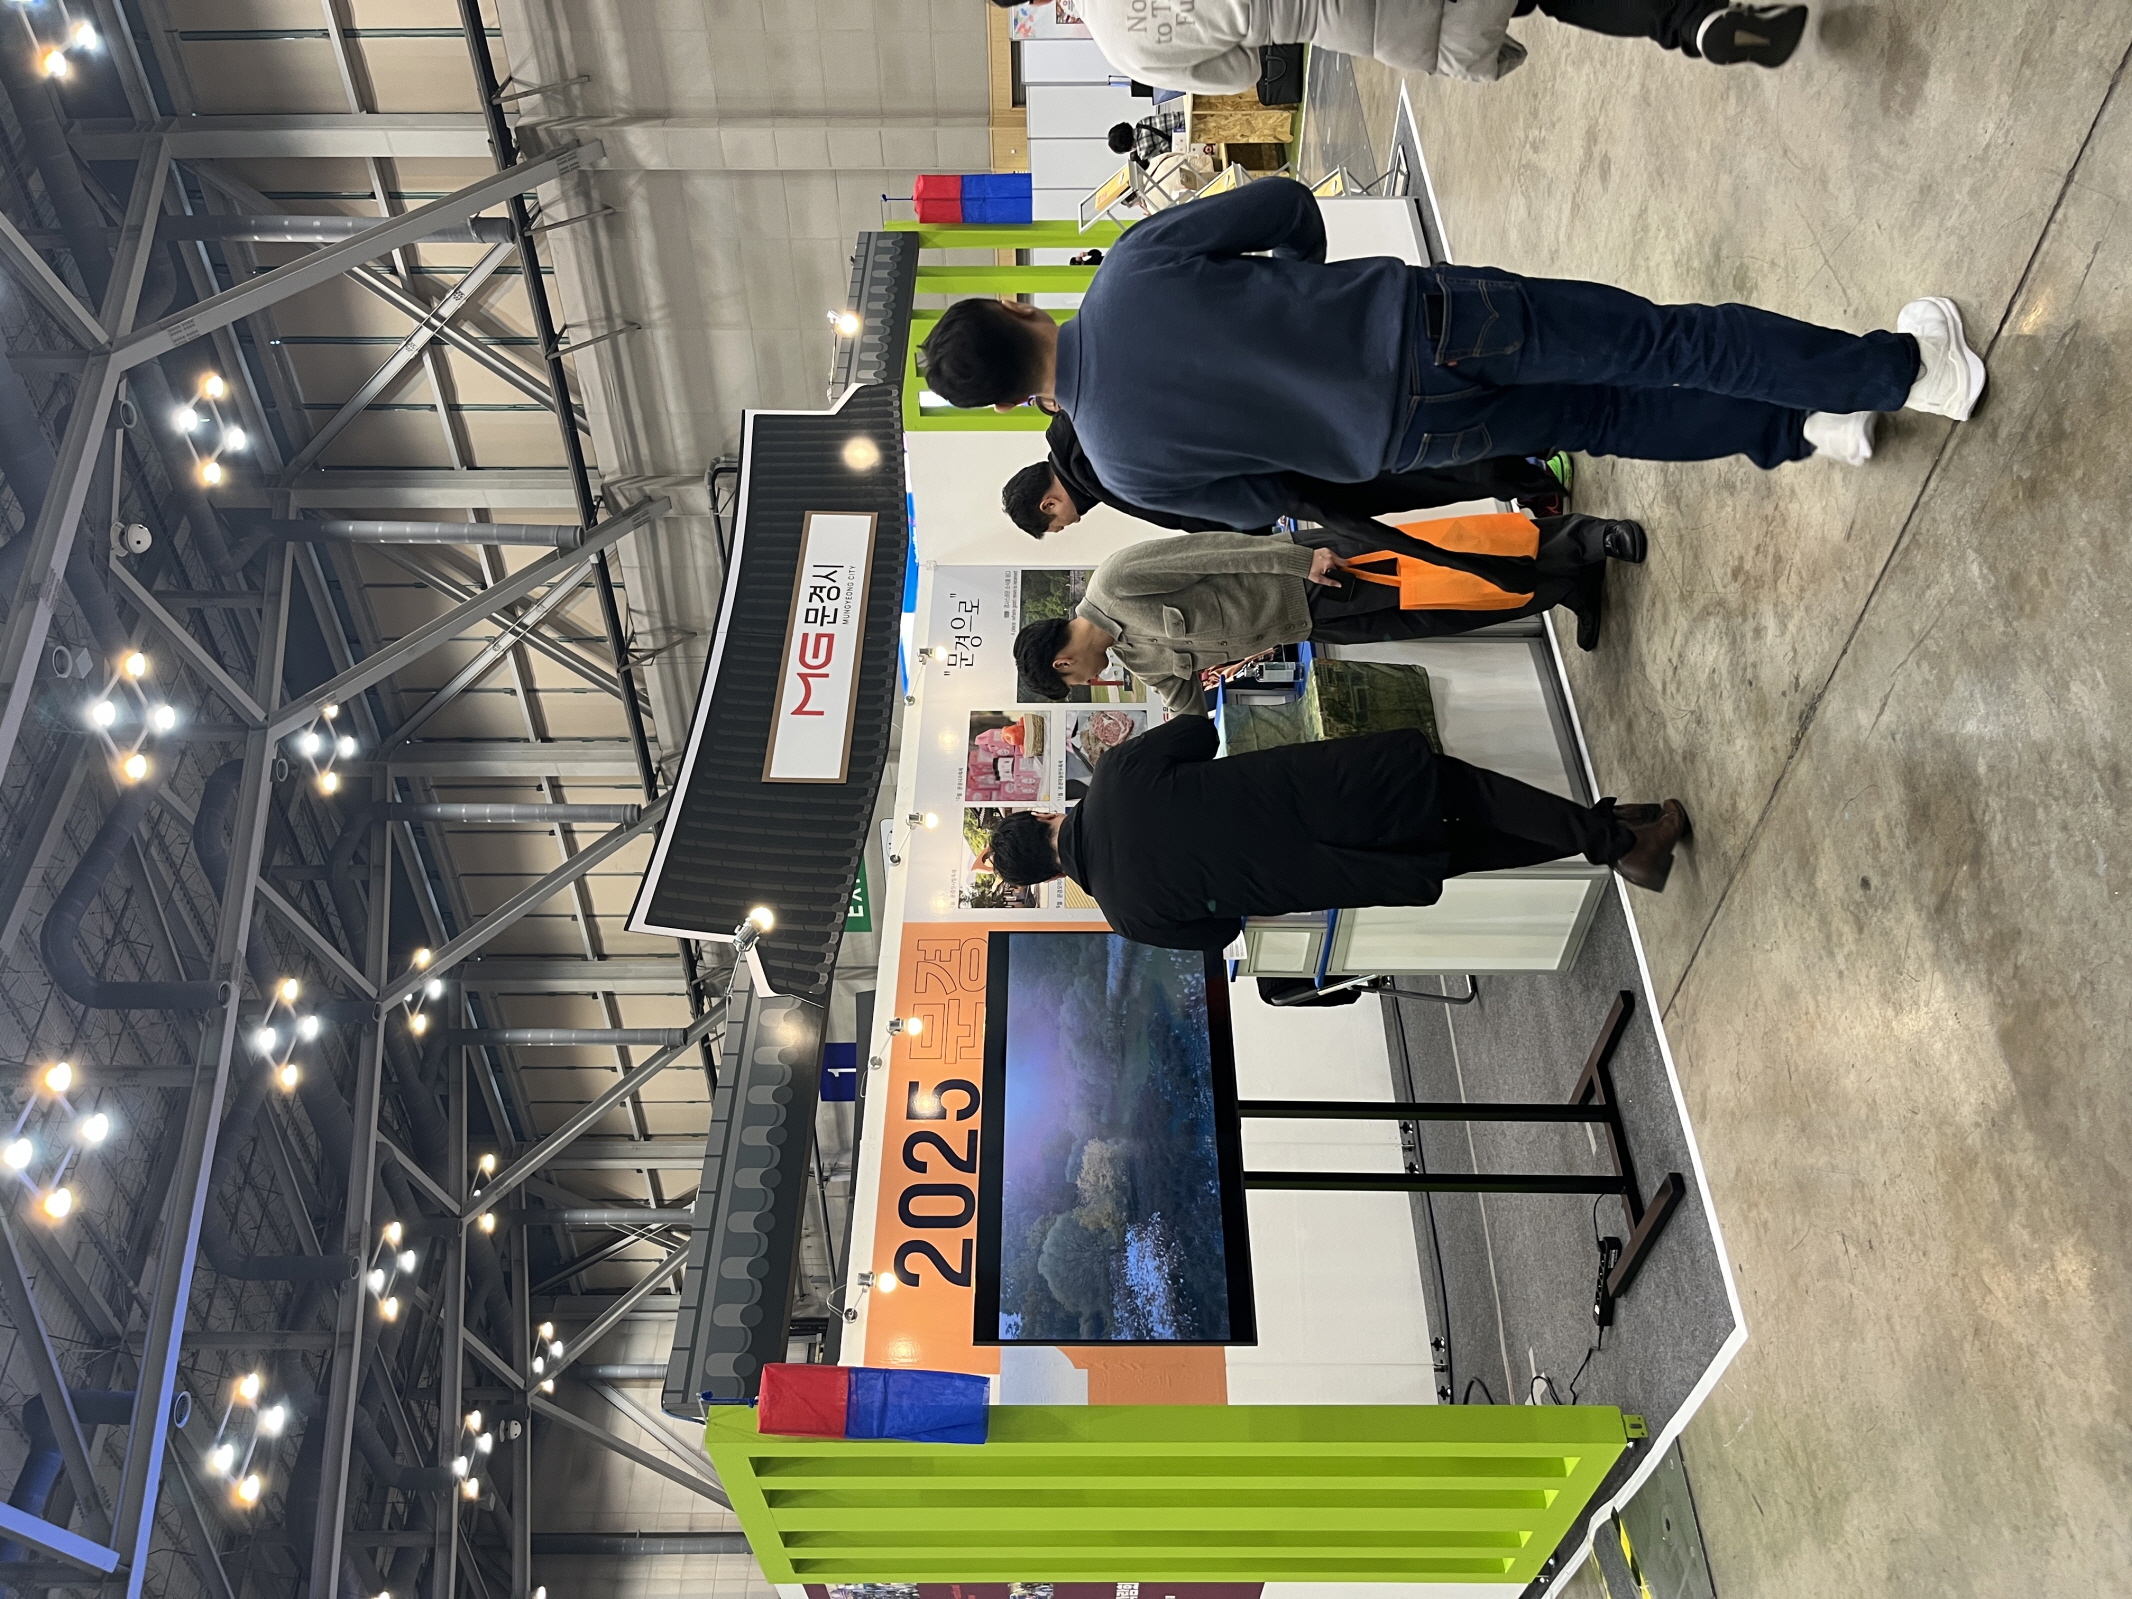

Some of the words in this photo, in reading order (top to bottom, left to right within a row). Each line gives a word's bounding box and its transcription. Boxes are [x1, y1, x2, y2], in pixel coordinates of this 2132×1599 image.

[1154, 22, 1172, 44] to
[1175, 0, 1195, 26] Fu
[804, 564, 844, 627] 문경시
[842, 582, 854, 625] MUNGYEONG
[848, 565, 856, 580] CITY
[943, 593, 982, 676] "문경으로"
[790, 633, 834, 716] MG
[909, 937, 987, 1064] 문경
[827, 1068, 857, 1077] 1
[893, 1079, 980, 1287] 2025
